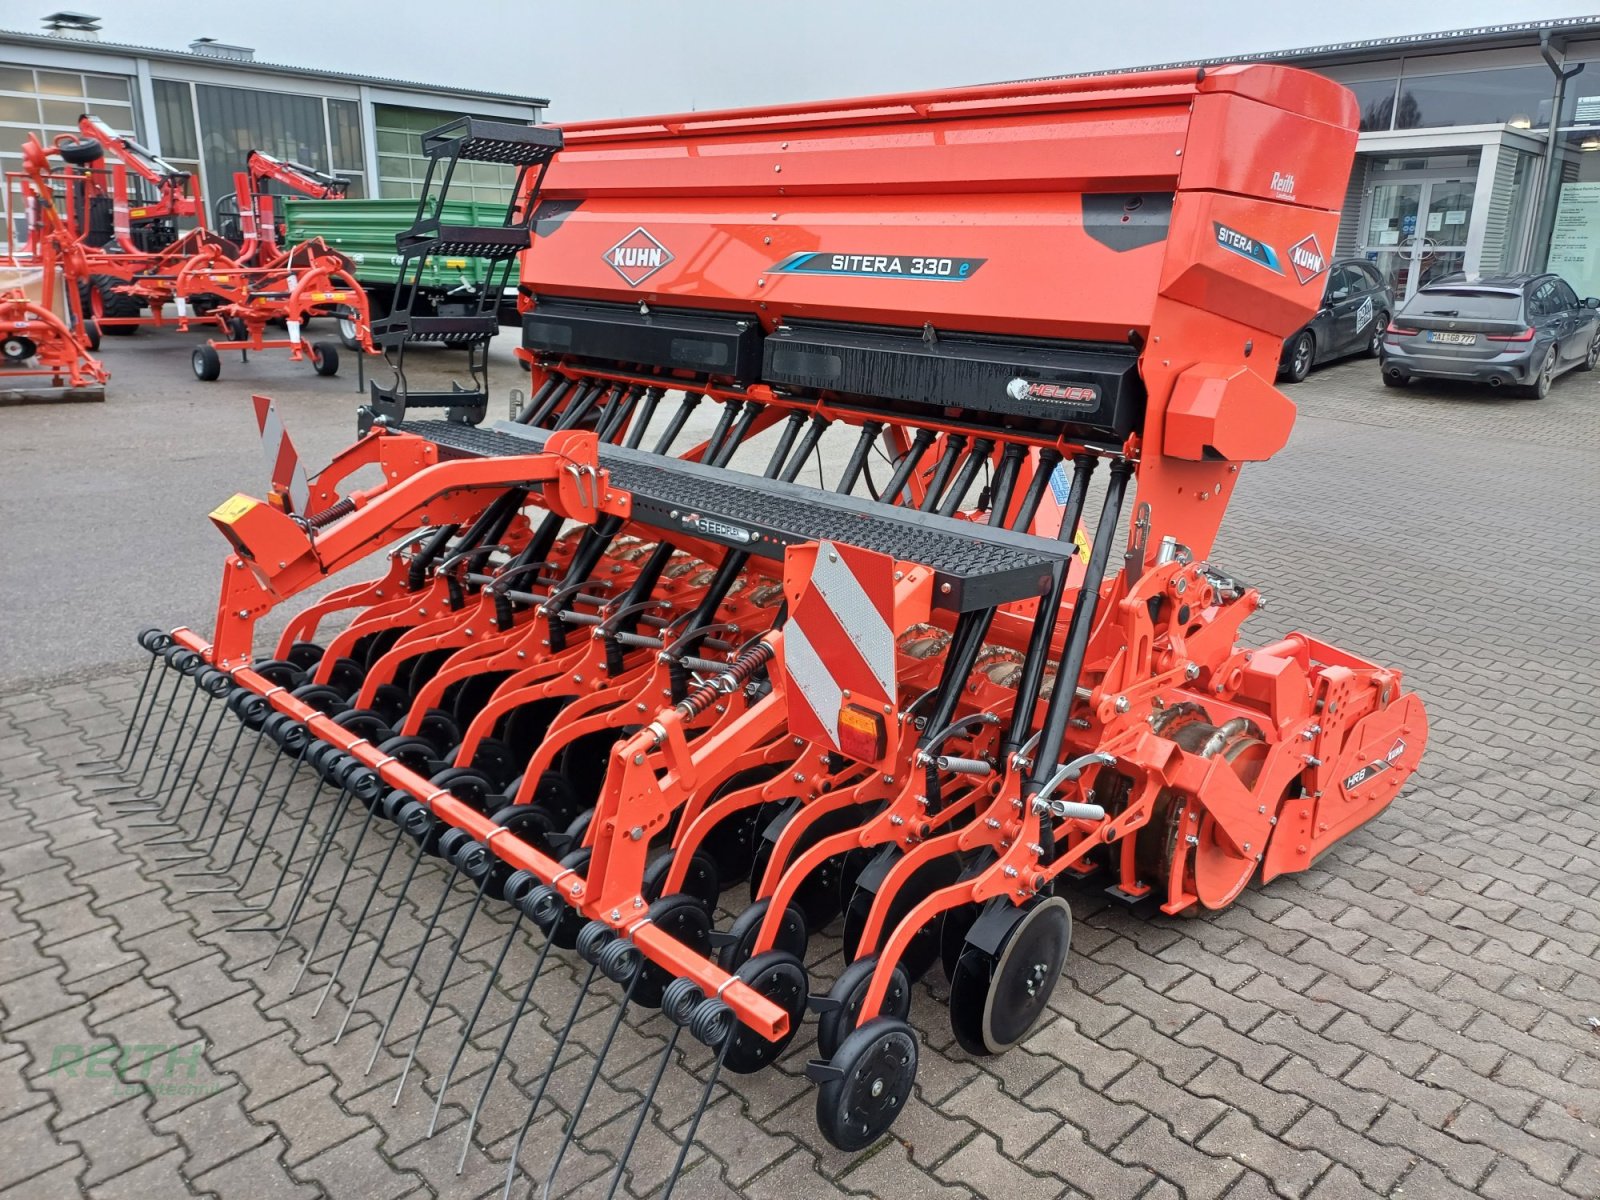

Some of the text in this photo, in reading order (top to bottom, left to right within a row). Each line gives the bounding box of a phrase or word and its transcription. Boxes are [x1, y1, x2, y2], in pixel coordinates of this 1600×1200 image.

[1218, 227, 1252, 254] SITERA
[614, 247, 661, 267] KUHN
[831, 255, 969, 276] SITERA 330 e
[1294, 247, 1322, 273] KUHN
[1461, 335, 1475, 343] 777
[1029, 383, 1093, 402] HELICA
